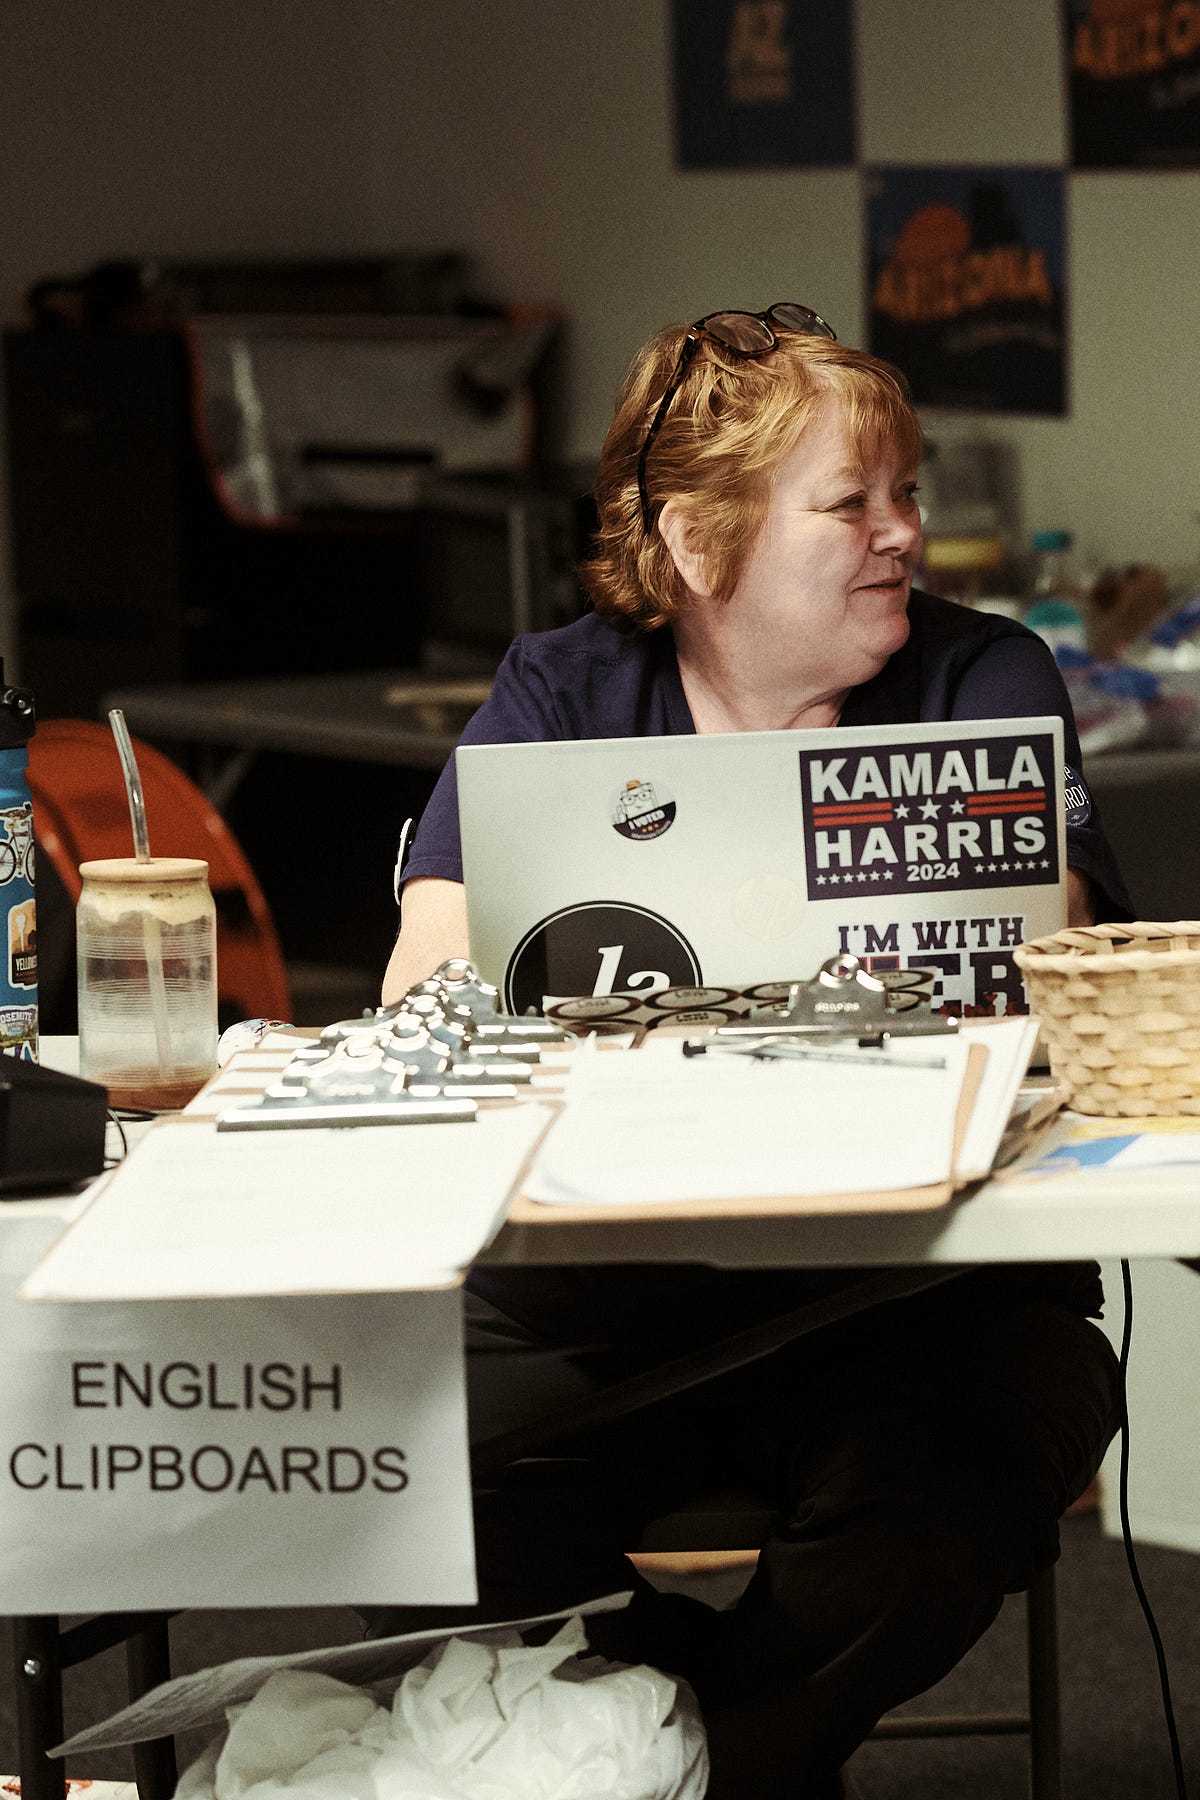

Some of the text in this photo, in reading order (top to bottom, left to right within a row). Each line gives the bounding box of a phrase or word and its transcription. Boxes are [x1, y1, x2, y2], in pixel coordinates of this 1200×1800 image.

[809, 745, 1046, 803] KAMALA
[633, 809, 666, 828] VOTED
[814, 816, 1047, 869] HARRIS
[906, 862, 961, 882] 2024
[838, 917, 1024, 954] I'M WITH
[838, 951, 1031, 1018] ER
[72, 1361, 342, 1412] ENGLISH
[9, 1443, 410, 1494] CLIPBOARDS
